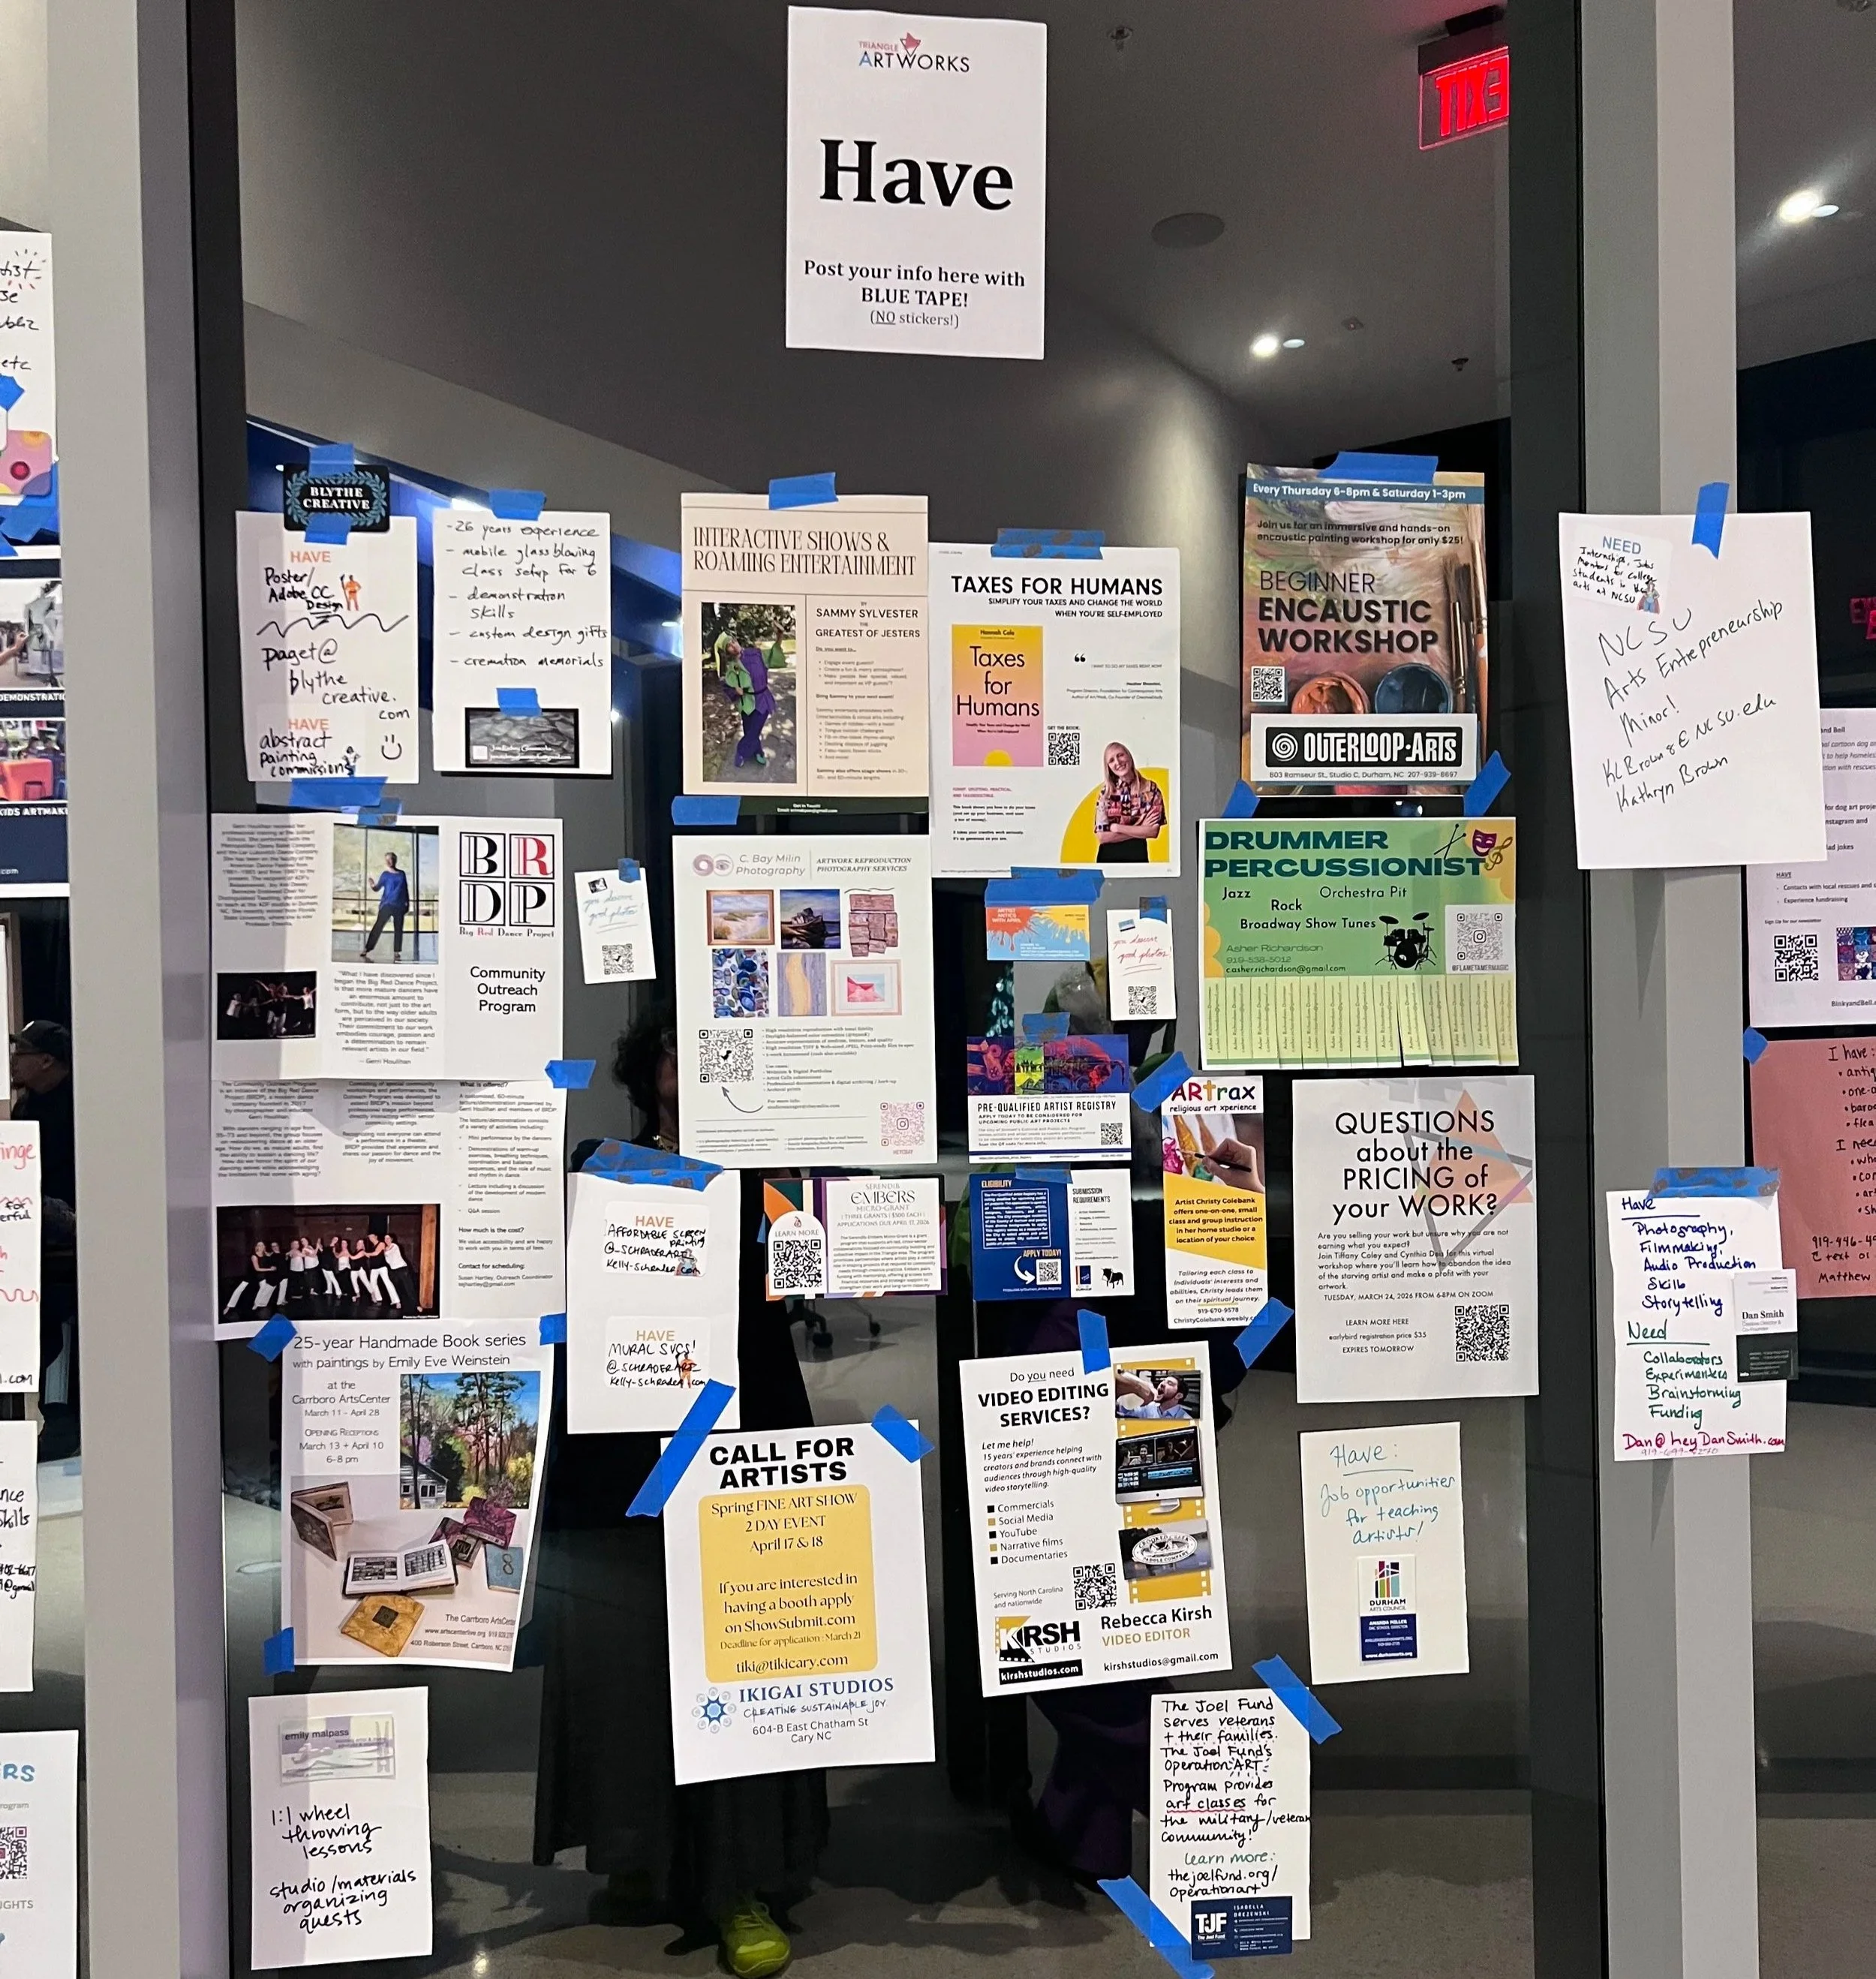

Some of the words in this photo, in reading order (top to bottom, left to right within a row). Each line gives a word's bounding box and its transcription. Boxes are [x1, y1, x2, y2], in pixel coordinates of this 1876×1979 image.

[858, 41, 898, 52] TRIANGLE
[860, 51, 969, 72] ARTWORKS
[820, 139, 1012, 210] Have
[805, 260, 843, 275] Post
[849, 262, 891, 281] your
[897, 265, 932, 281] info
[939, 267, 979, 284] here
[985, 272, 1024, 286] with
[862, 287, 909, 304] BLUE
[915, 290, 967, 307] TAPE!
[900, 312, 958, 329] stickers!)
[1254, 483, 1280, 497] Every
[1282, 486, 1331, 498] Thursday
[1334, 487, 1370, 498] 6-8pm
[1383, 489, 1430, 501] Saturday
[1433, 489, 1466, 501] 1-3pm
[303, 499, 370, 509] CREATIVE
[521, 527, 600, 540] experience
[694, 528, 802, 549] INTERACTIVE
[807, 531, 871, 551] SHOWS
[1603, 536, 1641, 554] NEED
[290, 551, 331, 563] HAVE
[695, 551, 774, 572] ROAMING
[781, 554, 916, 575] ENTERTAINMENT
[952, 576, 1012, 594] TAXES
[1022, 577, 1062, 594] FOR
[1072, 578, 1162, 595] HUMANS
[1261, 570, 1374, 593] BEGINNER
[467, 591, 564, 601] demonstration
[816, 609, 855, 617] SAMMY
[859, 609, 918, 618] SYLVESTER
[1259, 599, 1432, 623] ENCAUSTIC
[523, 626, 571, 645] design
[1258, 628, 1438, 654] WORKSHOP
[970, 646, 1024, 667] Taxes
[290, 669, 347, 695] blythe
[985, 671, 1012, 694] for
[958, 695, 1039, 716] Humans
[260, 728, 332, 749] abstract
[1205, 831, 1388, 850] DRUMMER
[753, 855, 773, 865] Bay
[1205, 858, 1486, 877] PERCUSSIONIST
[736, 867, 805, 876] Photography
[1222, 887, 1250, 900] Jazz
[1320, 886, 1384, 898] Orchestra
[1390, 886, 1406, 897] Pit
[1272, 898, 1302, 910] Rock
[1241, 918, 1300, 931] Broadway
[1306, 917, 1336, 928] Show
[1342, 918, 1375, 928] Tunes
[471, 967, 545, 982] Community
[478, 983, 537, 995] Outreach
[480, 1000, 535, 1015] Program
[979, 1102, 1040, 1111] PRE-QUALIFIED
[1045, 1102, 1072, 1111] ARTIST
[1077, 1101, 1115, 1110] REGISTRY
[1170, 1105, 1201, 1114] religious
[1336, 1110, 1494, 1134] QUESTIONS
[1357, 1138, 1428, 1162] about
[1438, 1137, 1472, 1160] the
[1345, 1166, 1454, 1190] PRICING
[1465, 1164, 1488, 1187] of
[1333, 1200, 1389, 1225] your
[1399, 1193, 1496, 1217] WORK?
[636, 1216, 674, 1228] HAVE
[1818, 1271, 1870, 1283] Matthew
[1760, 1310, 1784, 1318] Smith
[637, 1331, 675, 1341] HAVE
[1628, 1319, 1667, 1340] Need
[294, 1337, 354, 1351] 25-year
[360, 1335, 437, 1348] Handmade
[443, 1334, 480, 1347] Book
[486, 1337, 526, 1346] series
[609, 1343, 654, 1357] MURAL
[389, 1357, 420, 1369] Emily
[425, 1356, 446, 1367] Eve
[452, 1355, 510, 1366] Weinstein
[290, 1395, 335, 1404] Carrboro
[339, 1394, 390, 1403] ArtsCenter
[979, 1390, 1033, 1406] VIDEO
[1038, 1383, 1108, 1402] EDITING
[1000, 1406, 1090, 1427] SERVICES?
[1649, 1404, 1702, 1430] Funding
[710, 1443, 786, 1465] CALL
[796, 1438, 854, 1459] FOR
[720, 1462, 846, 1489] ARTISTS
[1356, 1477, 1455, 1505] opportunities
[998, 1499, 1054, 1512] Commercials
[1377, 1504, 1438, 1522] teaching
[1000, 1527, 1037, 1538] YouTube
[1101, 1614, 1166, 1629] Rebecca
[1172, 1605, 1212, 1622] Kirsh
[1102, 1633, 1141, 1646] VIDEO
[1145, 1628, 1190, 1642] EDITOR
[737, 1656, 847, 1673] tiki@tikicary.com
[999, 1665, 1078, 1681] kirshstudios.com
[740, 1685, 801, 1702] IKIGAI
[810, 1678, 893, 1696] STUDIOS
[1195, 1700, 1228, 1713] Joel
[1237, 1696, 1273, 1710] Fund
[1164, 1718, 1209, 1728] serves
[1219, 1716, 1275, 1726] veterans
[284, 1732, 309, 1741] emily
[312, 1728, 349, 1738] malpass
[791, 1734, 813, 1743] Cary
[817, 1731, 831, 1740] NC
[299, 1803, 350, 1822] wheel
[282, 1823, 382, 1840] throwing
[303, 1839, 371, 1859] lessons
[284, 1890, 386, 1916] organizing
[1195, 1913, 1227, 1933] TJF
